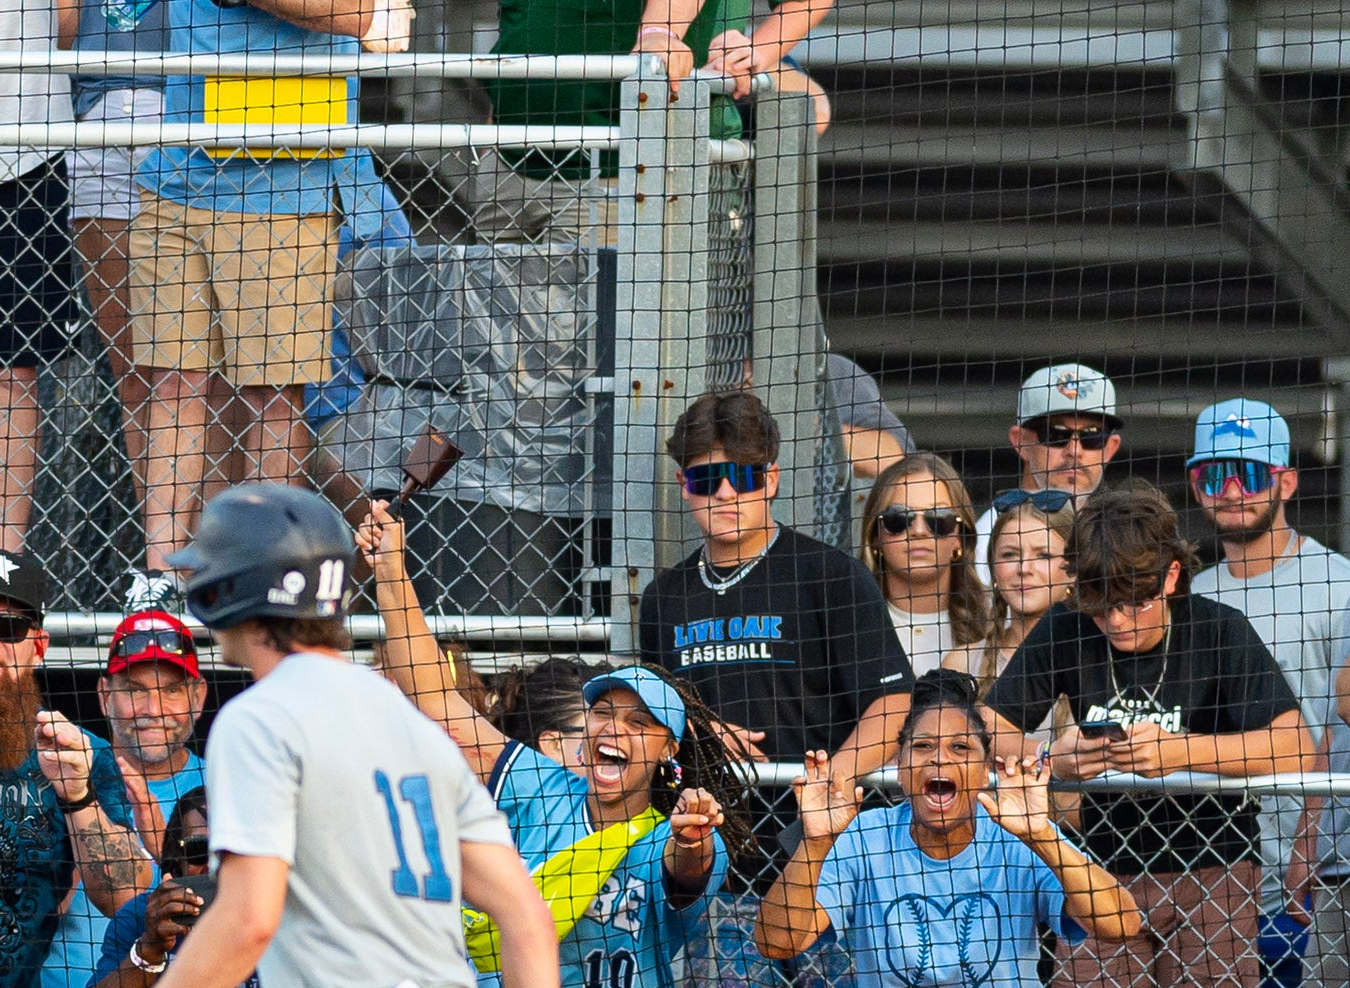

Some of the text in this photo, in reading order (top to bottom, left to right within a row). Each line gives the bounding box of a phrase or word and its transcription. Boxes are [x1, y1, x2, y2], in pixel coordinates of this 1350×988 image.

[316, 558, 344, 601] 11
[673, 615, 783, 648] LIVE OAK
[680, 642, 772, 667] BASEBALL
[372, 768, 453, 904] 11
